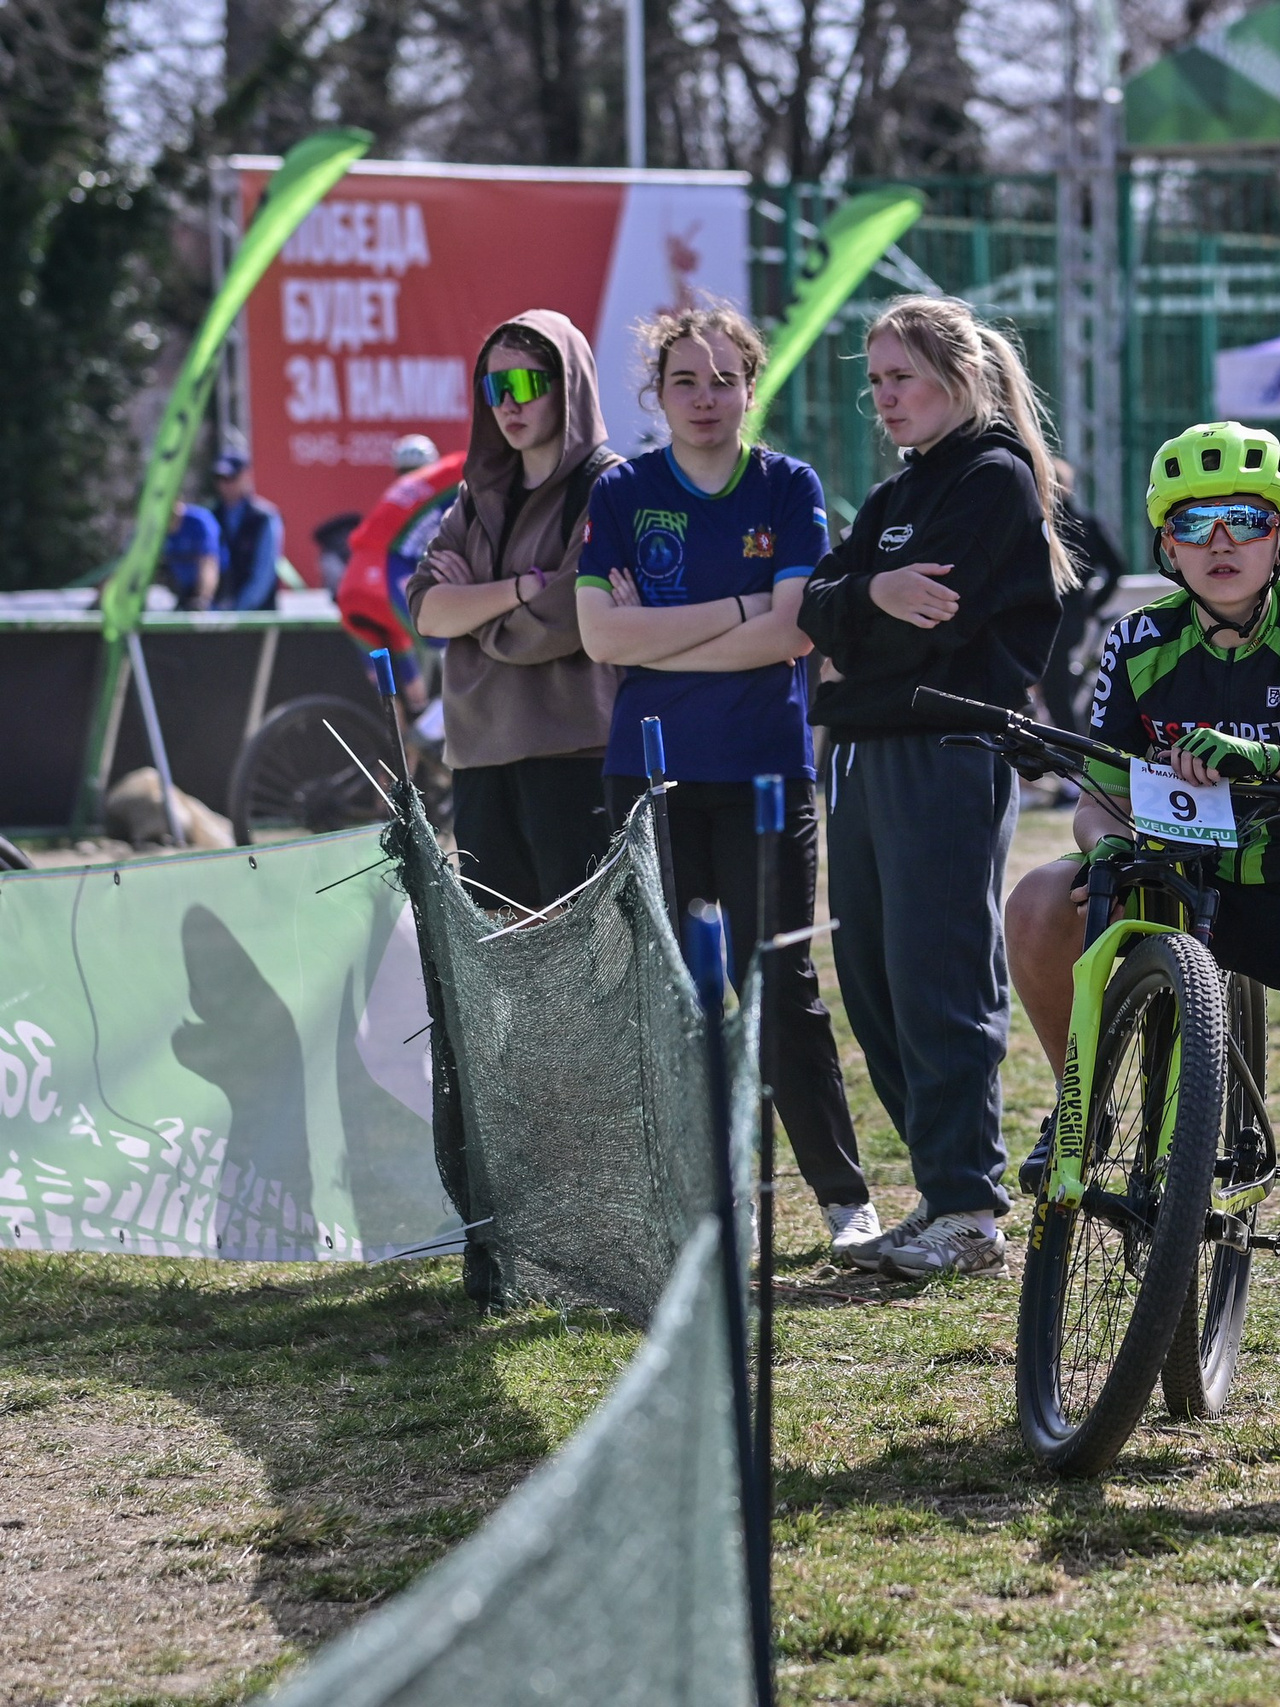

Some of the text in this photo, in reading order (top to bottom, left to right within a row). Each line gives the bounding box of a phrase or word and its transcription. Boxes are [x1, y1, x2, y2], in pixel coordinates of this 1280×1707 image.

[281, 278, 400, 353] БУДЕТ
[285, 354, 342, 424] ЗА
[1090, 614, 1162, 729] RUSSIA
[1141, 819, 1231, 840] VELOTV.RU
[1169, 790, 1197, 821] 9
